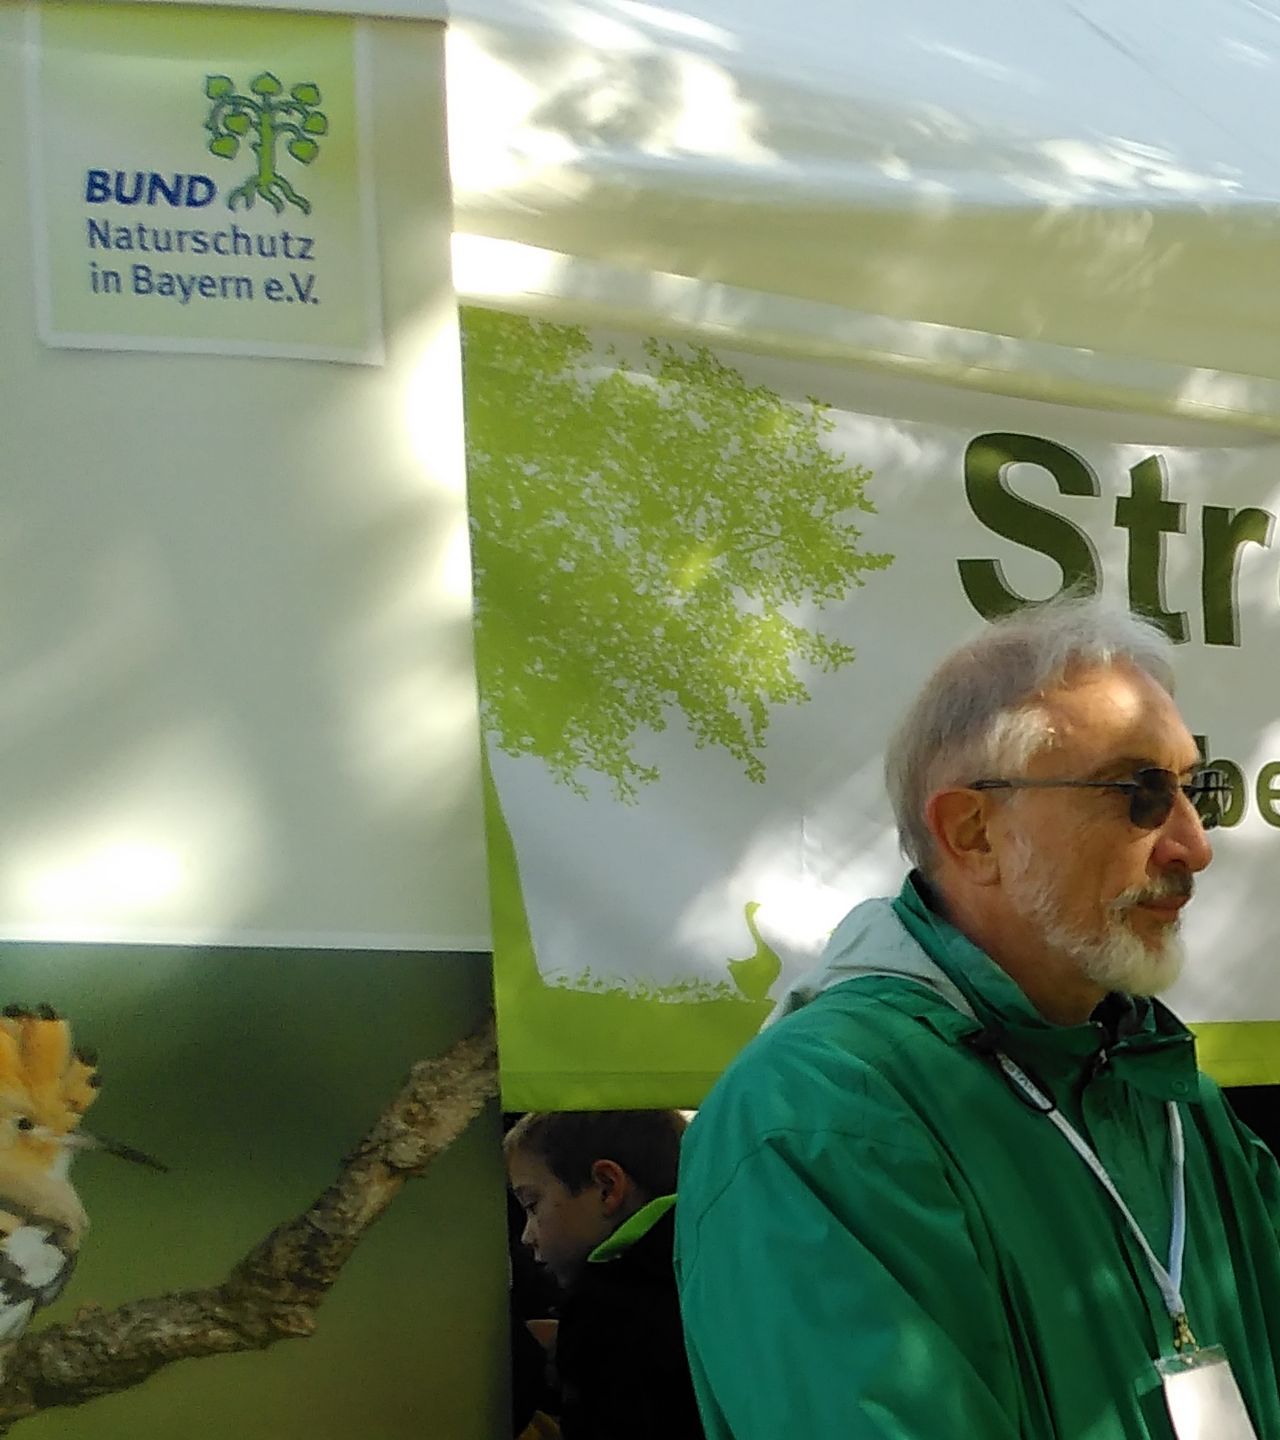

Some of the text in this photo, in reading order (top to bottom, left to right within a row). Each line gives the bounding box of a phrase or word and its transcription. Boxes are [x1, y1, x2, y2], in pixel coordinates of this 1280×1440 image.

[86, 170, 216, 208] BUND
[86, 218, 316, 261] Naturschutz
[90, 262, 320, 304] in Bayern e.V.
